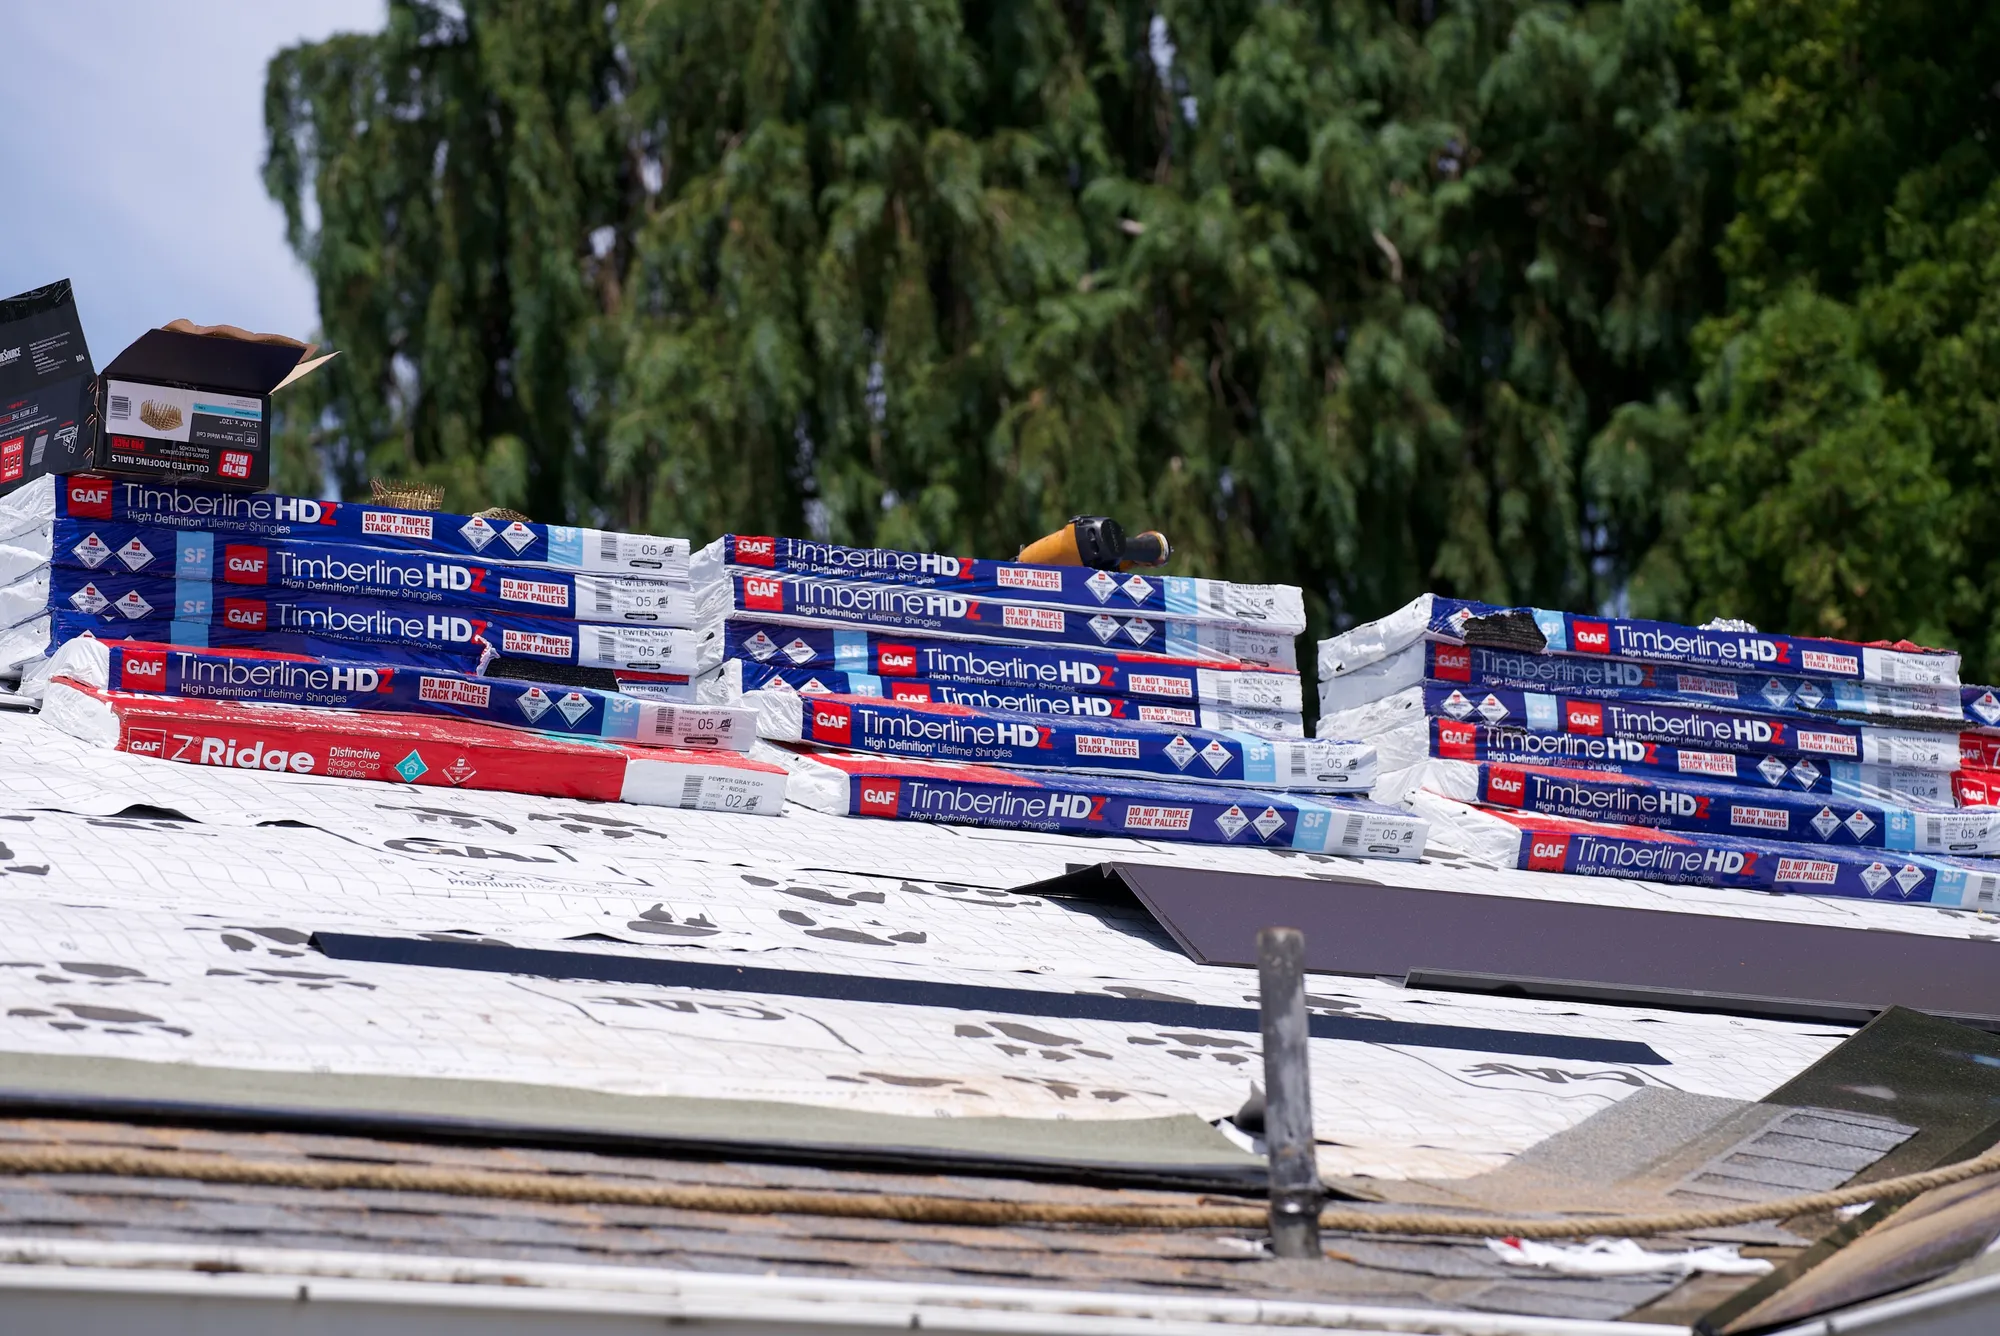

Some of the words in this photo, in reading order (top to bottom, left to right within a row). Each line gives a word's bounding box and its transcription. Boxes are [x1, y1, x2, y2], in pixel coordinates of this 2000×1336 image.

[207, 432, 220, 440] Weld
[246, 436, 256, 444] RF
[111, 454, 134, 464] NAILS
[135, 457, 171, 468] ROOFING
[192, 452, 210, 460] CLAVOS
[225, 453, 249, 464] Rite
[172, 461, 210, 473] COLLATED
[222, 463, 247, 477] Grip
[71, 488, 109, 504] GAF
[122, 483, 271, 519] Timberline
[365, 513, 378, 523] DO
[380, 514, 399, 525] NOT
[400, 517, 431, 528] TRIPLE
[365, 522, 391, 533] STACK
[393, 525, 430, 537] PALLETS
[555, 527, 575, 543] SF
[184, 548, 206, 564] SF
[642, 545, 657, 555] 05
[739, 540, 771, 555] GAF
[788, 539, 918, 571] Timberline
[228, 557, 265, 573] GAF
[276, 551, 424, 587] Timberline
[1000, 568, 1012, 578] DO
[1015, 570, 1031, 580] NOT
[1033, 571, 1059, 582] TRIPLE
[282, 578, 305, 590] High
[307, 580, 356, 594] Definition
[361, 584, 400, 598] Lifetime
[402, 587, 442, 601] Shingles
[999, 577, 1025, 586] STACK
[1027, 580, 1060, 590] PALLETS
[1170, 580, 1190, 595] SF
[636, 597, 651, 607] 05
[747, 580, 779, 597] GAF
[794, 582, 924, 615] Timberline
[228, 609, 264, 625] GAF
[276, 603, 424, 638] Timberline
[1577, 631, 1606, 645] GAF
[1614, 626, 1738, 658] Timberline
[639, 646, 655, 657] 05
[126, 659, 163, 675] GAF
[176, 652, 330, 690] Timberline
[882, 653, 914, 667] GAF
[924, 648, 1059, 681] Timberline
[1436, 656, 1469, 668] GAF
[1480, 650, 1601, 685] Timberline
[181, 683, 205, 696] High
[208, 685, 259, 698] Definition
[263, 689, 302, 701] Lifetime
[306, 692, 347, 704] Shingles
[423, 678, 435, 689] DO
[438, 680, 455, 690] NOT
[457, 683, 488, 695] TRIPLE
[422, 687, 447, 699] STACK
[449, 691, 488, 705] PALLETS
[896, 693, 928, 702] GAF
[937, 687, 1070, 715] Timberline
[612, 700, 635, 714] SF
[698, 718, 713, 730] 05
[816, 712, 848, 729] GAF
[859, 710, 995, 744] Timberline
[1570, 712, 1600, 726] GAF
[1608, 706, 1732, 739] Timberline
[130, 740, 161, 752] GAF
[864, 737, 887, 749] High
[889, 739, 933, 753] Definition
[937, 743, 972, 756] Lifetime
[975, 747, 1013, 760] Shingles
[1078, 736, 1089, 745] DO
[1092, 737, 1108, 747] NOT
[1110, 739, 1137, 748] TRIPLE
[1442, 731, 1473, 745] GAF
[1486, 727, 1605, 758] Timberline
[200, 737, 315, 774] Ridge
[329, 747, 381, 760] Distinctive
[1078, 744, 1102, 754] STACK
[1104, 746, 1137, 757] PALLETS
[1250, 749, 1271, 761] SF
[1912, 752, 1926, 762] 03
[328, 758, 356, 769] Ridge
[358, 760, 381, 771] Cap
[1327, 758, 1342, 769] 05
[326, 767, 367, 779] Shingles
[708, 776, 734, 784] PEWTER
[734, 779, 751, 787] GRAY
[725, 794, 742, 808] 02
[864, 789, 896, 805] GAF
[908, 782, 1046, 818] Timberline
[1491, 777, 1522, 792] GAF
[1532, 776, 1658, 813] Timberline
[1129, 806, 1141, 817] DO
[1144, 808, 1162, 818] NOT
[1162, 810, 1190, 820] TRIPLE
[1127, 815, 1152, 826] STACK
[1153, 818, 1188, 828] PALLETS
[1303, 813, 1325, 828] SF
[1891, 818, 1909, 831] SF
[1382, 829, 1398, 840] 05
[1961, 829, 1974, 839] 05
[1534, 843, 1565, 858] GAF
[1578, 836, 1703, 871] Timberline
[1780, 860, 1791, 870] DO
[1793, 861, 1810, 871] NOT
[1811, 863, 1836, 872] TRIPLE
[1576, 864, 1597, 876] High
[1599, 867, 1640, 879] Definition
[1644, 870, 1676, 882] Lifetime
[1679, 874, 1714, 885] Shingles
[1777, 870, 1801, 880] STACK
[1803, 872, 1834, 882] PALLETS
[448, 878, 528, 890] Premium
